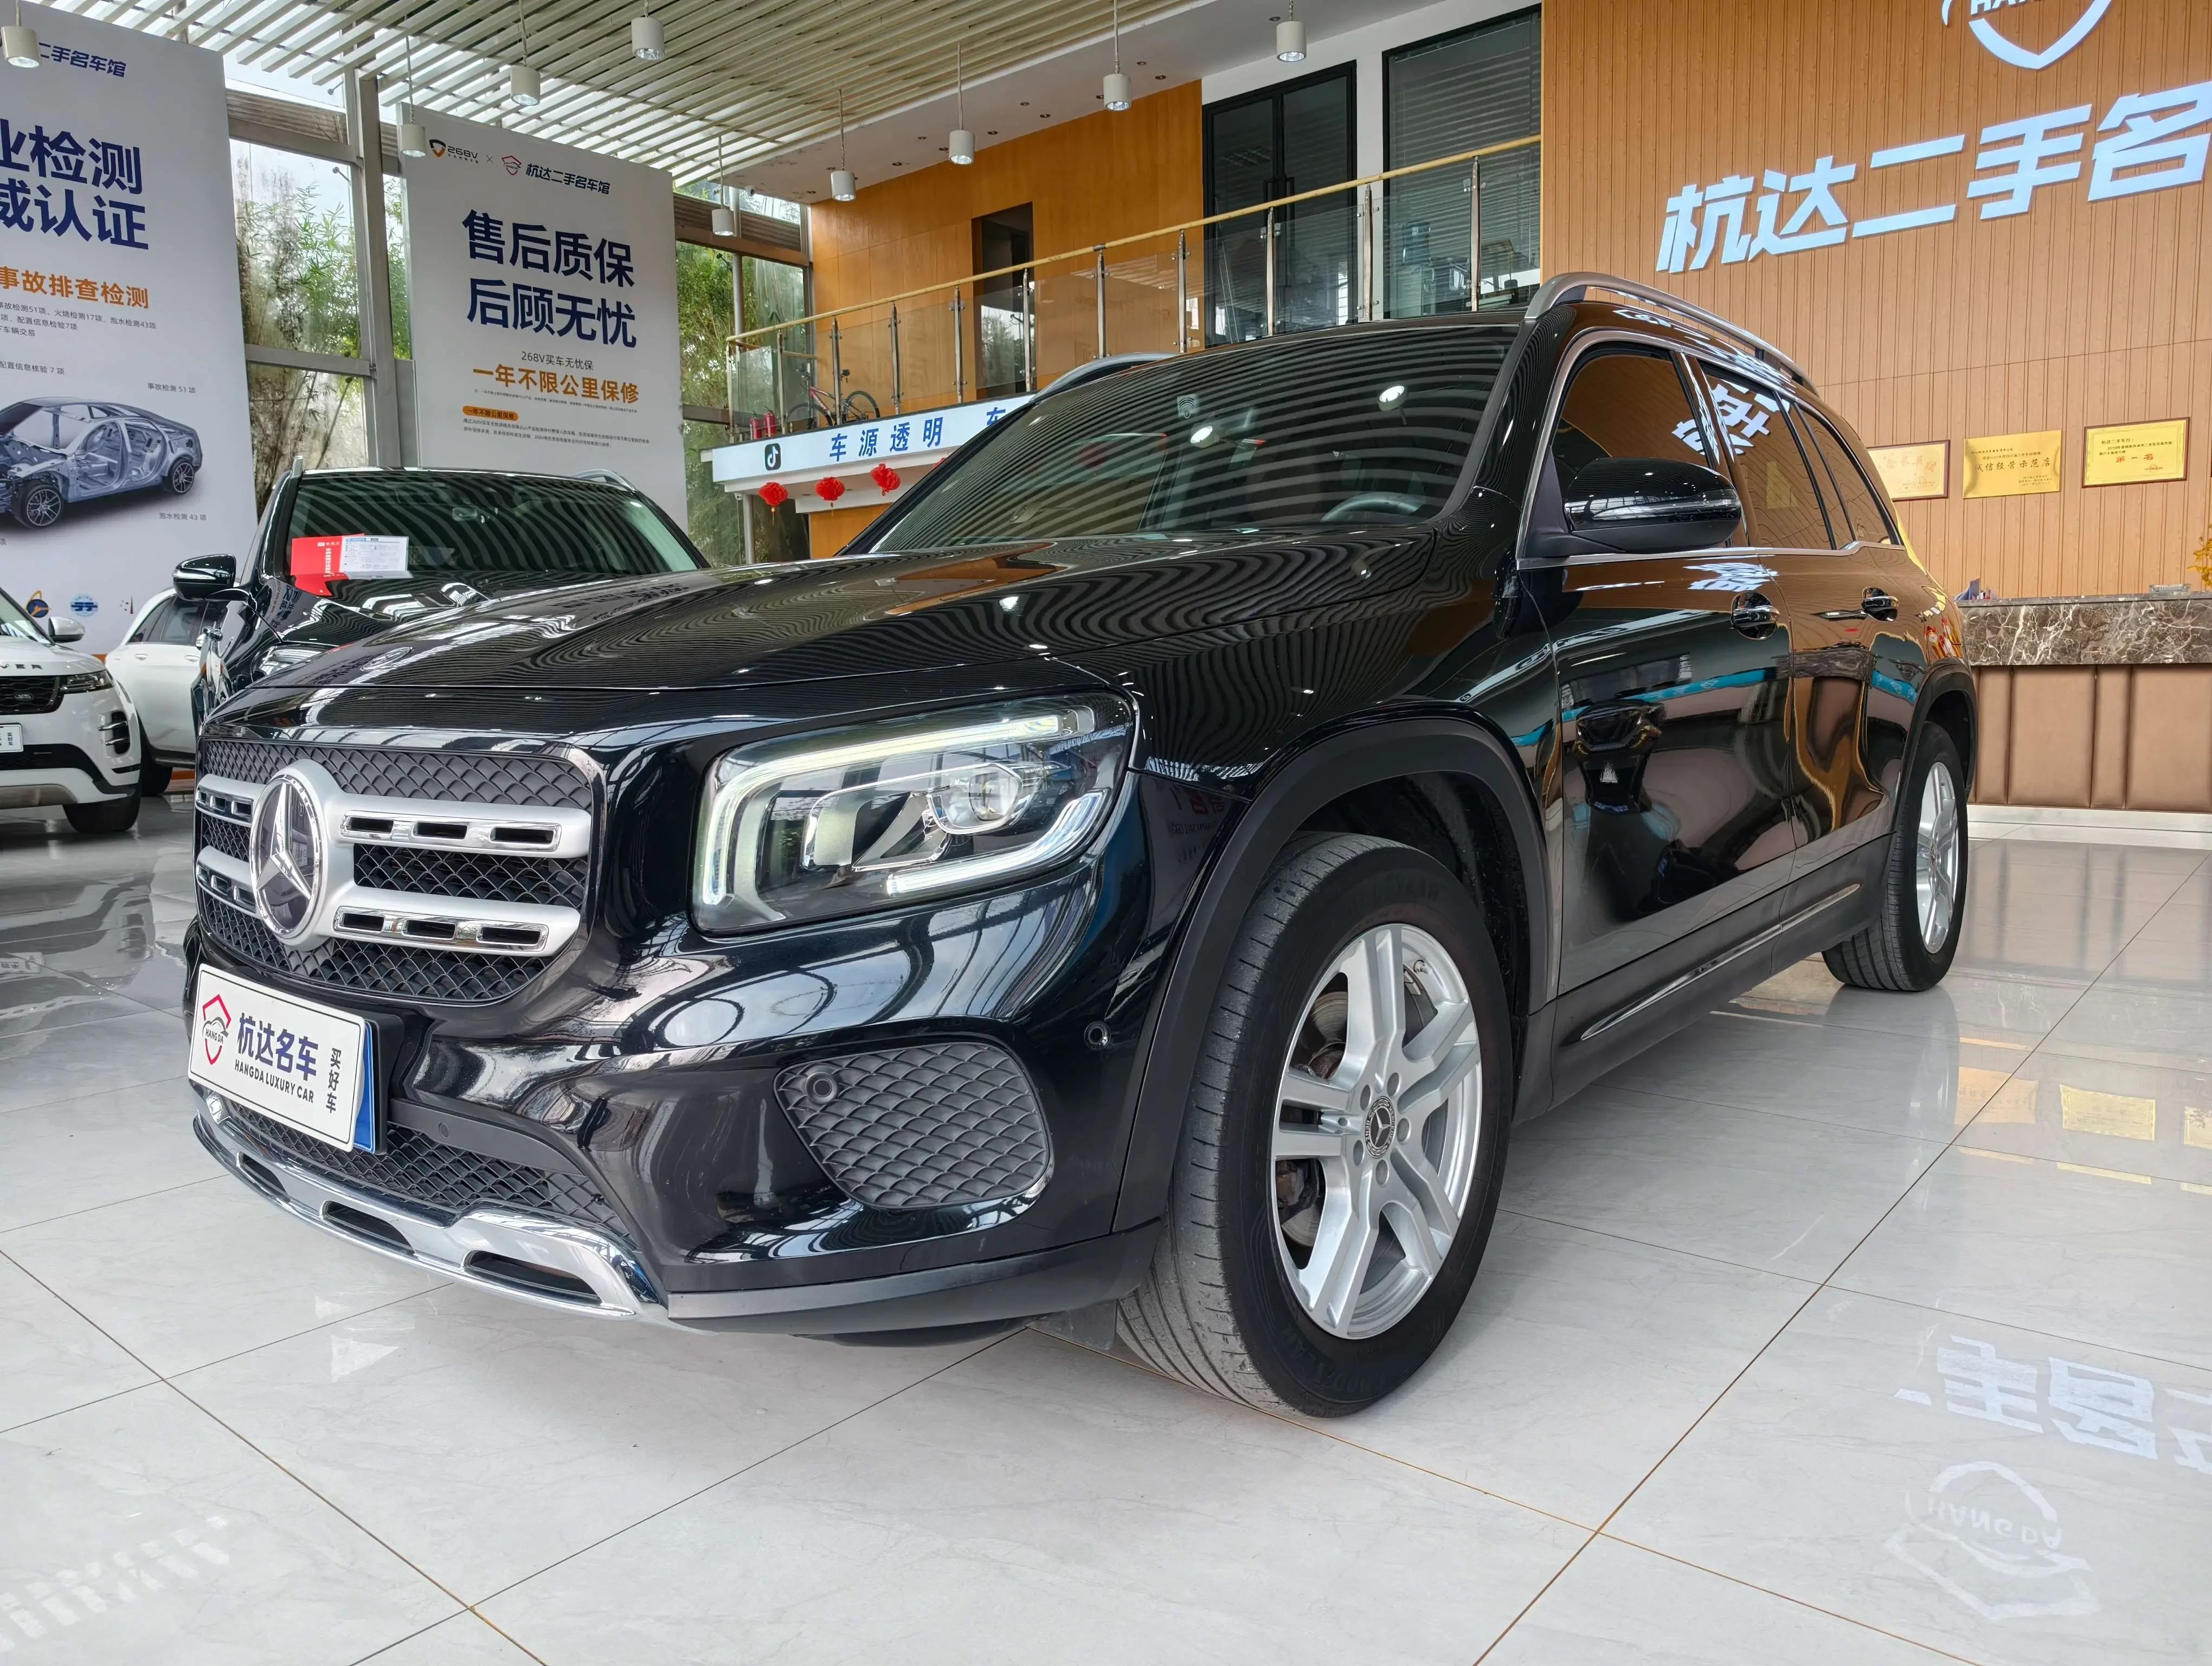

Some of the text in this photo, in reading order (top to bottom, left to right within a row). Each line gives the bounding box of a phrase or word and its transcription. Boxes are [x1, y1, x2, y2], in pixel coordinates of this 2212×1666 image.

[448, 146, 478, 159] 268V
[526, 163, 610, 195] 杭达二手名车馆
[1656, 80, 2212, 274] 杭达二手名
[462, 209, 634, 287] 售后质保
[467, 278, 636, 348] 后顾无忧
[473, 363, 639, 403] 一年不限公里保修
[522, 351, 594, 371] 268V买车无忧保
[829, 417, 943, 462] 车源透明
[205, 1028, 217, 1041] HANG
[238, 1013, 319, 1081] 杭达名车
[235, 1059, 314, 1103] HANGDA LUXURY CAR
[326, 1048, 342, 1113] 买好车
